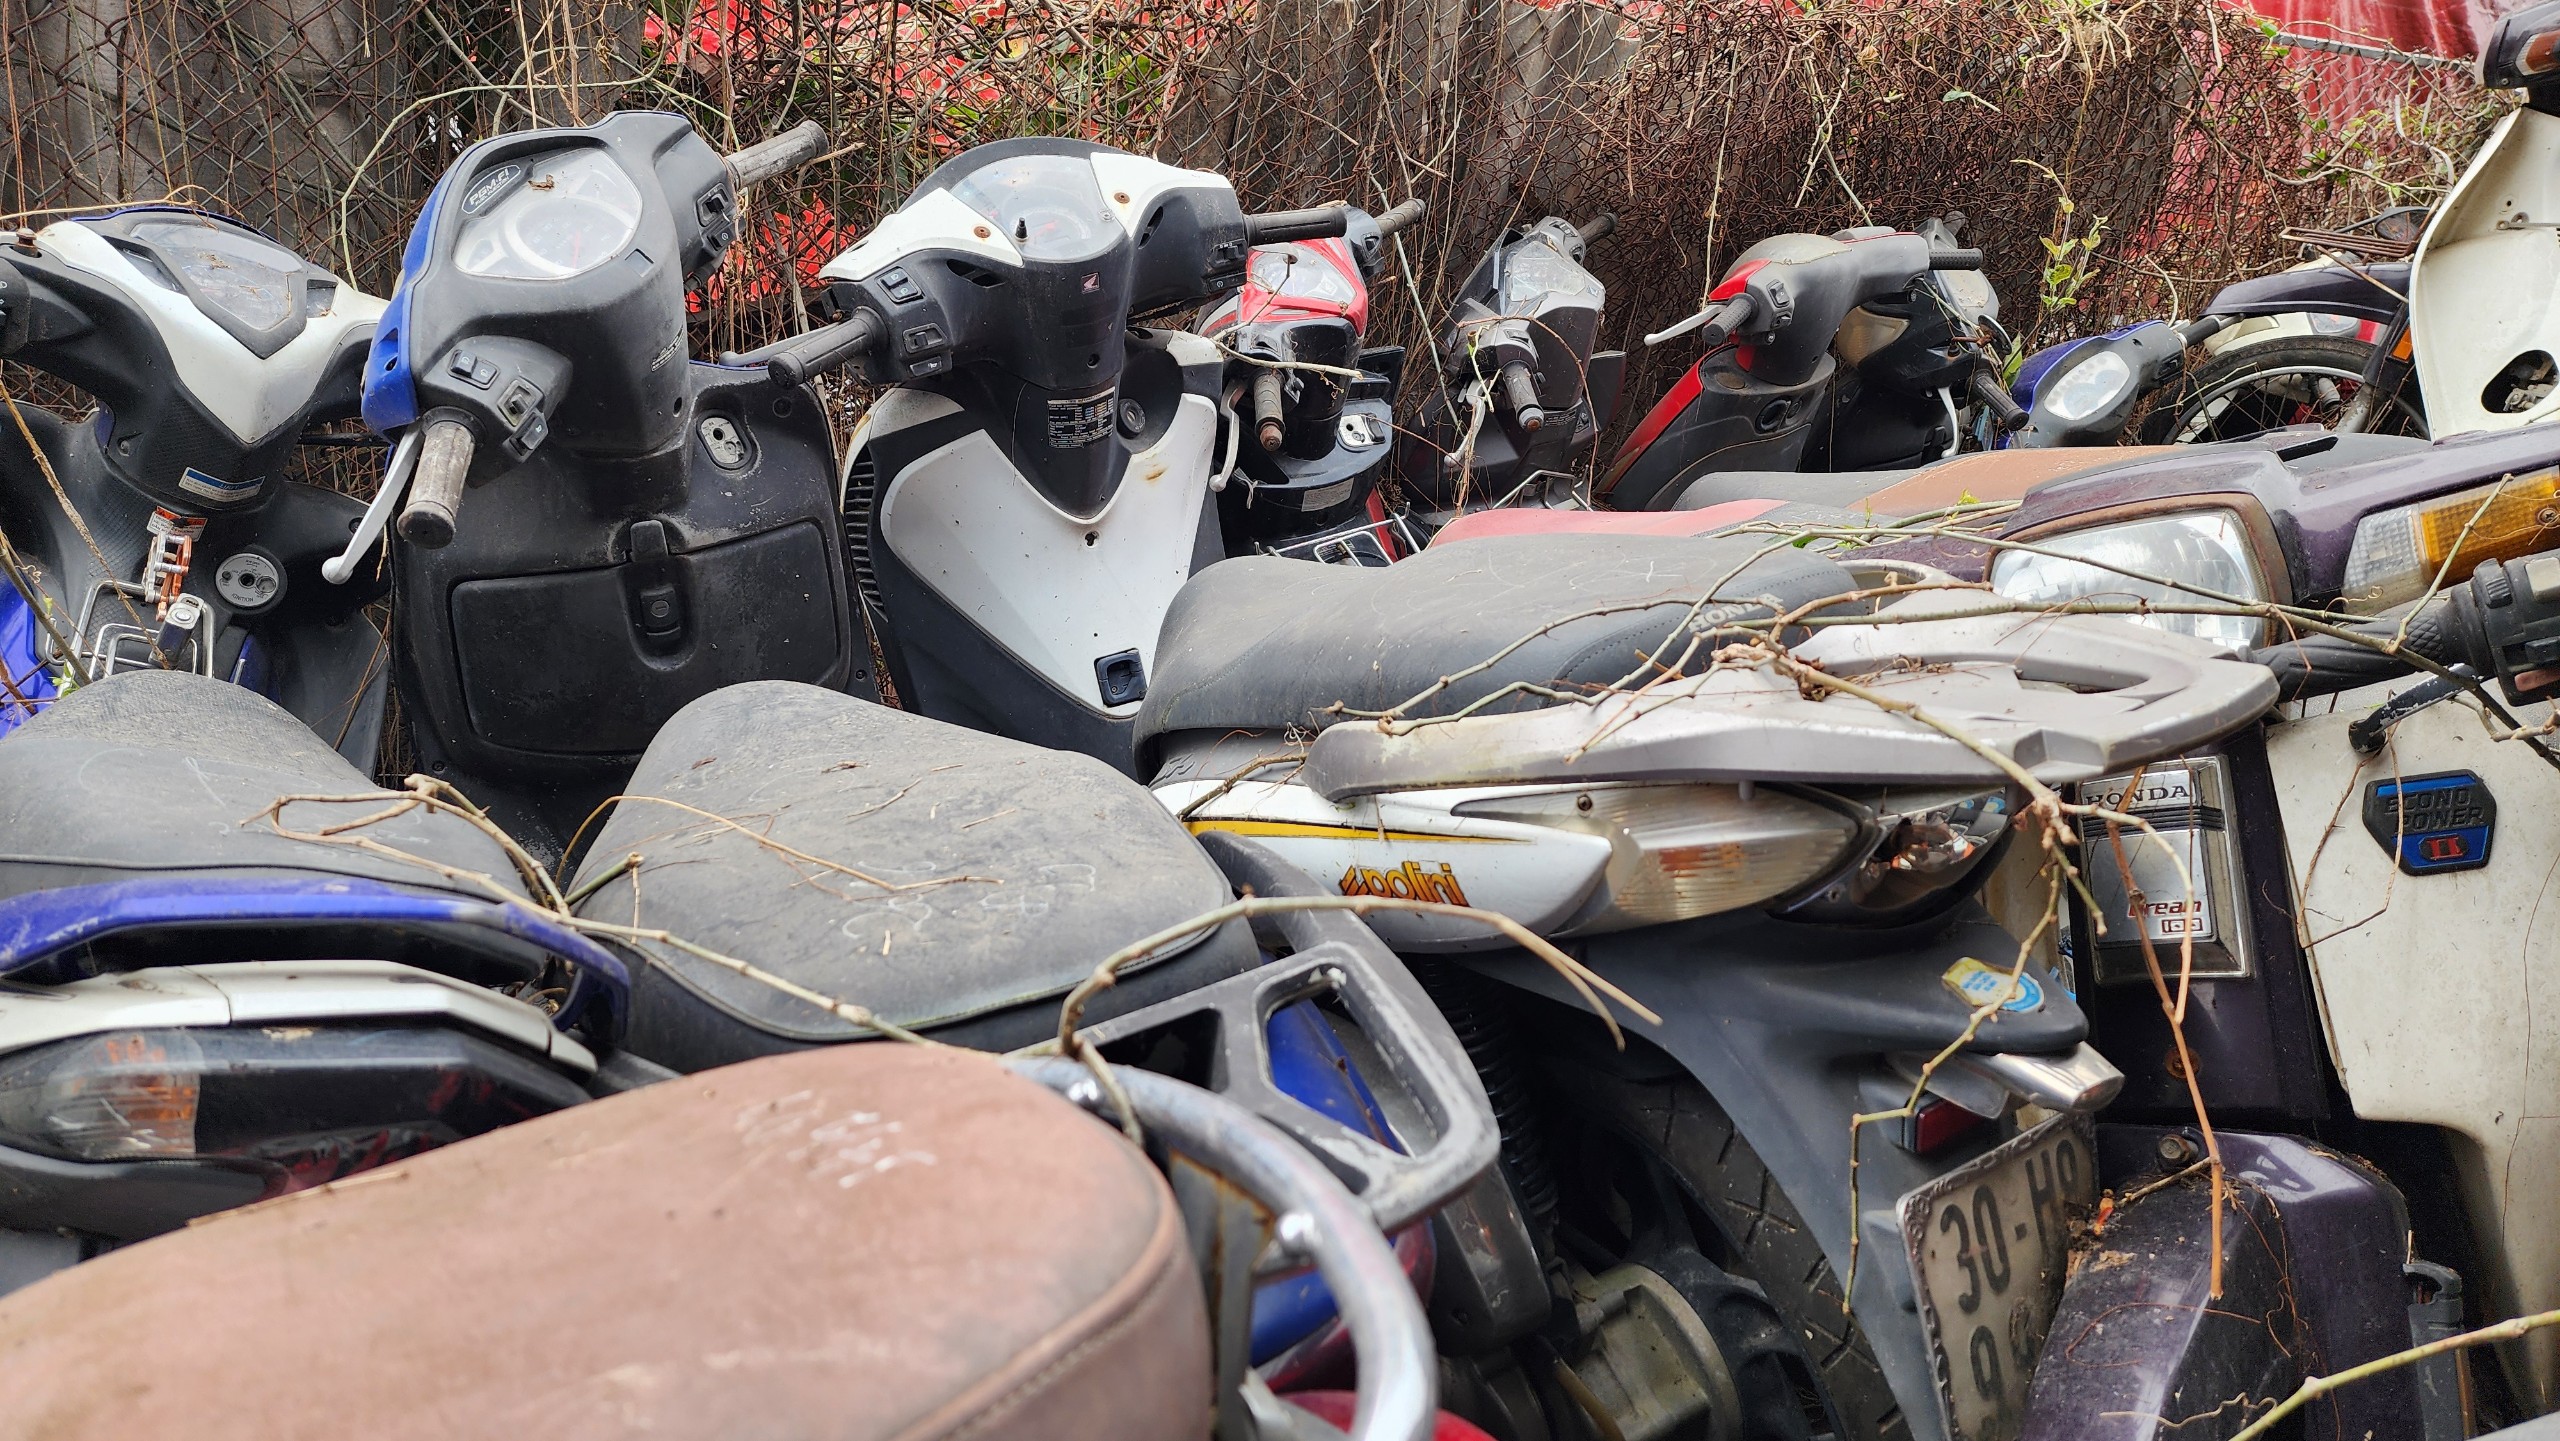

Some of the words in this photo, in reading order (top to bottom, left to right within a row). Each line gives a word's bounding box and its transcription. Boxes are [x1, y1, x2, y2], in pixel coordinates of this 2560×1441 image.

[232, 592, 254, 602] IGNITION
[2085, 784, 2190, 806] HONDA
[2384, 787, 2472, 815] ECONO
